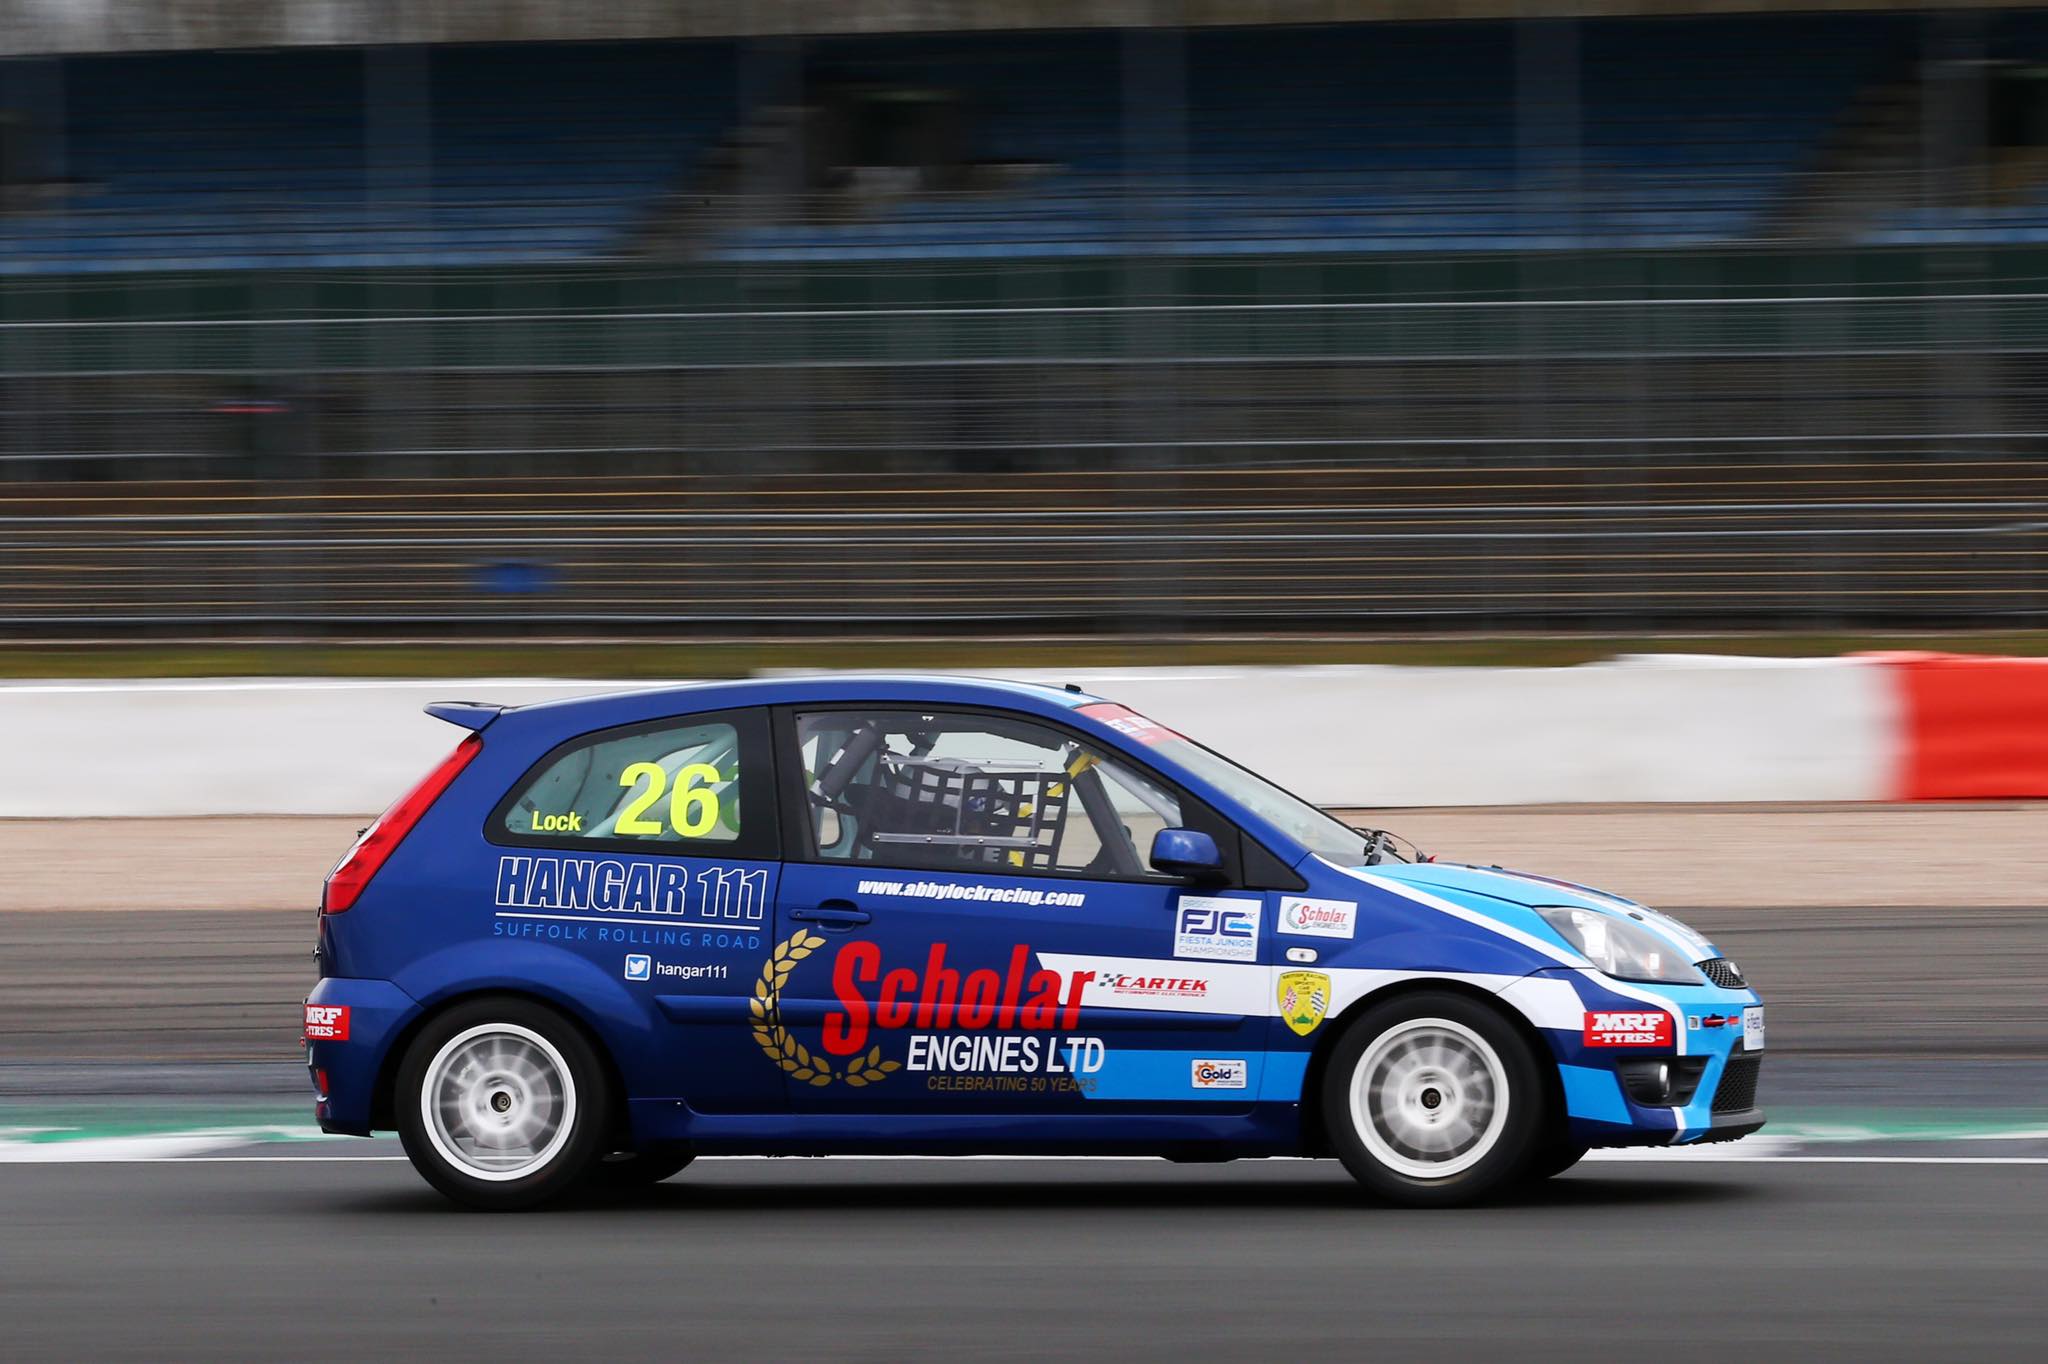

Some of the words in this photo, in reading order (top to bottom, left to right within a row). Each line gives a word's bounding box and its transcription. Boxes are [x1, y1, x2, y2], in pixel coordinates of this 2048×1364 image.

[614, 762, 720, 838] 26
[531, 810, 581, 832] Lock
[495, 856, 688, 915] HANGAR
[697, 867, 768, 920] 111
[857, 880, 1085, 907] www.abbylockracing.com
[1180, 908, 1253, 938] FJC
[1298, 905, 1347, 924] Scholar
[494, 922, 588, 941] SUFFOLK
[599, 928, 692, 946] ROLLING
[702, 934, 760, 950] ROAD
[1179, 935, 1212, 945] FIESTA
[1215, 938, 1253, 948] JUNIOR
[656, 962, 728, 979] hangar111
[1115, 976, 1208, 991] CARTEK
[822, 940, 1096, 1056] Scholar
[1592, 1013, 1664, 1031] MRF
[906, 1035, 1041, 1073] ENGINES
[1046, 1036, 1105, 1073] LTD
[927, 1075, 1028, 1091] CELEBRATING
[1030, 1077, 1047, 1092] 50
[1050, 1077, 1098, 1093] YEARS
[1201, 1068, 1231, 1079] Gold
